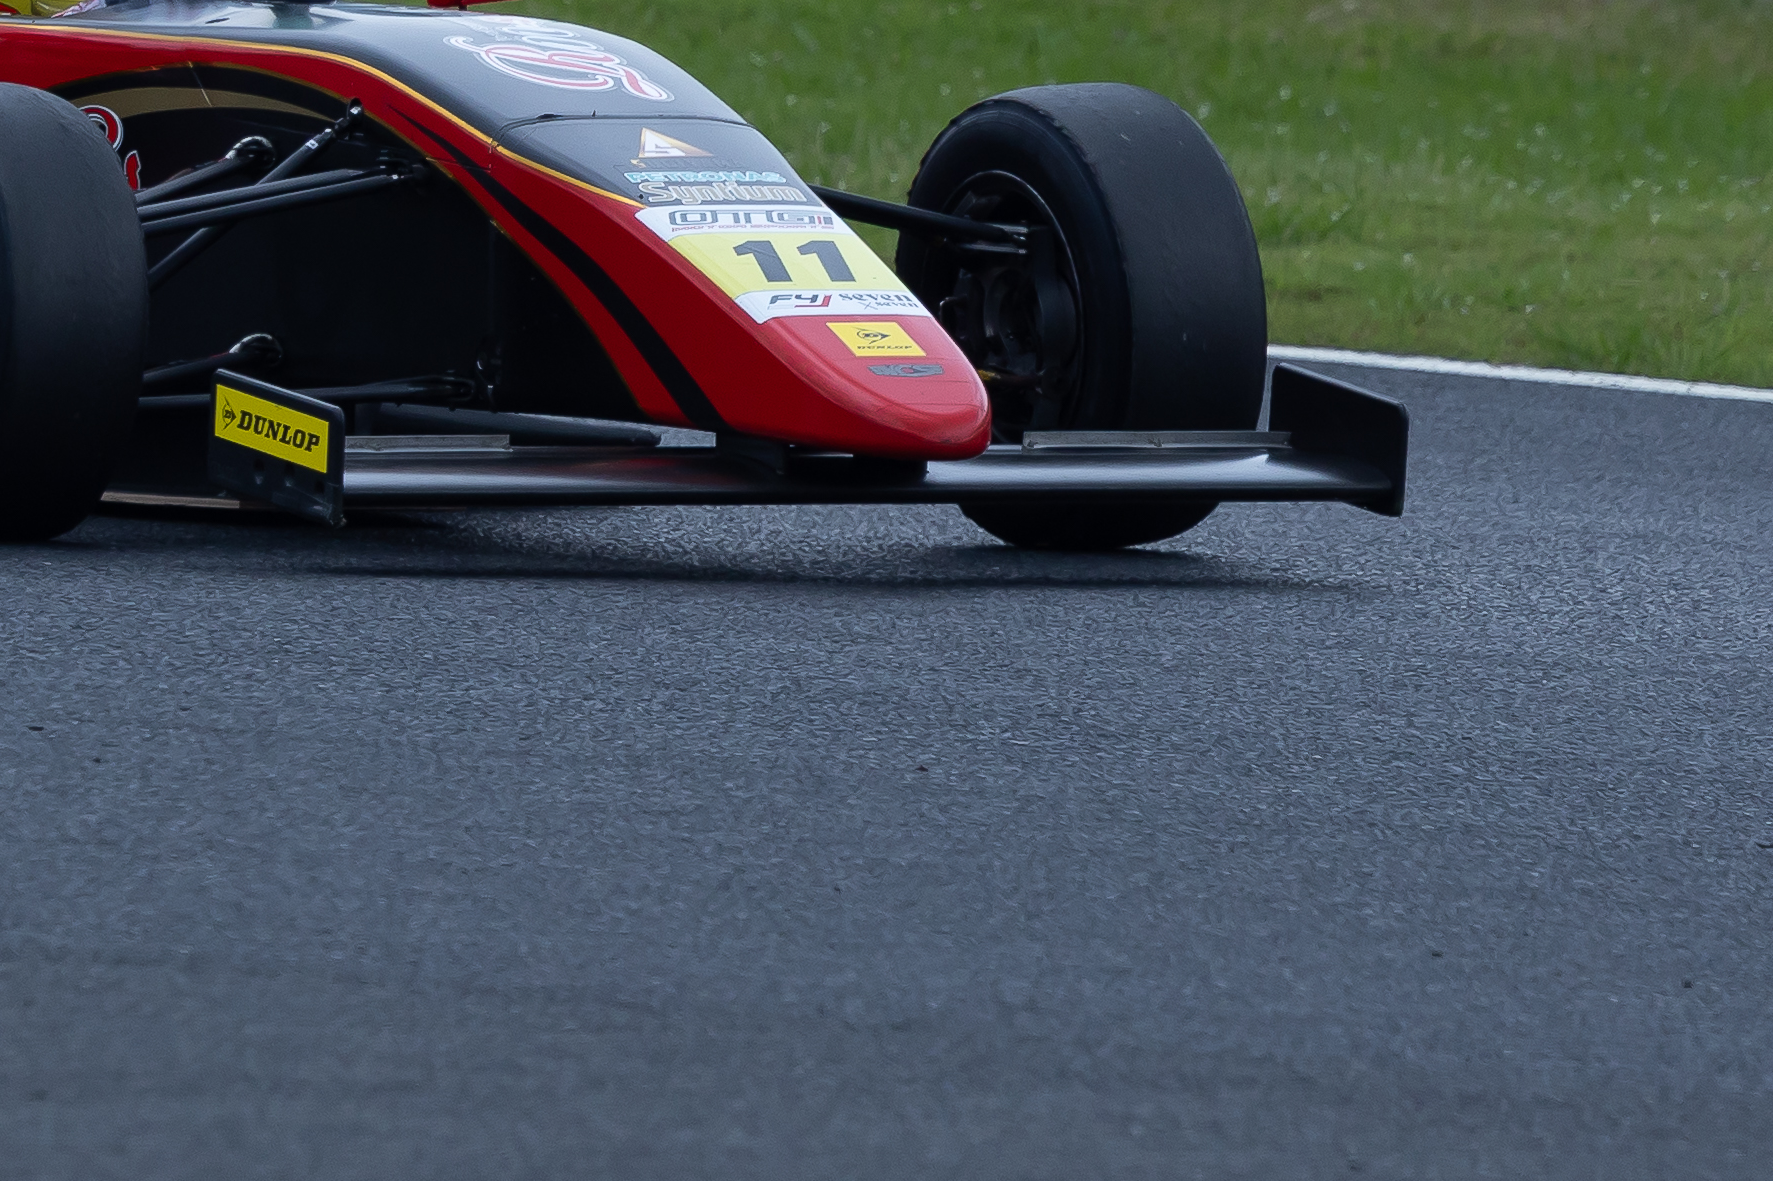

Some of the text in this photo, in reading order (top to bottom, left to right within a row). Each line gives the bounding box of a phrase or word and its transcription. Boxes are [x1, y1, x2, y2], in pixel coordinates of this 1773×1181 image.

[625, 171, 787, 184] PETRONAS
[639, 181, 808, 205] Syntium
[733, 240, 856, 283] 11
[236, 409, 321, 453] DUNLOP
